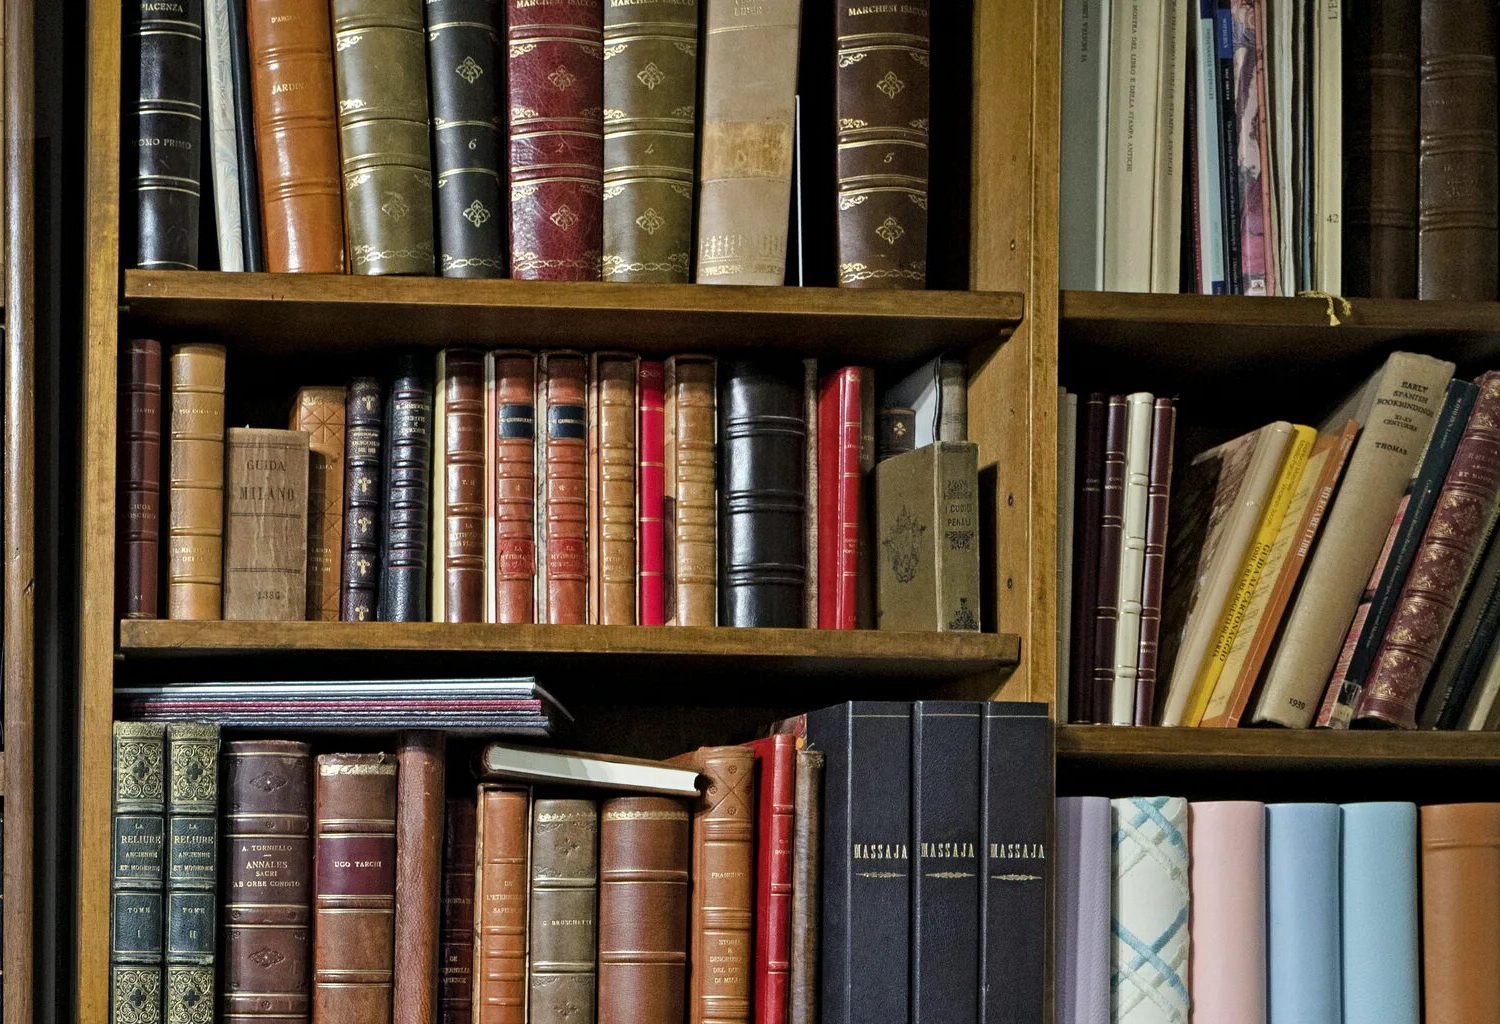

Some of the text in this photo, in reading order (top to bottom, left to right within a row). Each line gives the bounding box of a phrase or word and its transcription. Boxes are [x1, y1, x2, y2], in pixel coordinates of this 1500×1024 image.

[848, 5, 898, 17] MARCHESI
[468, 138, 478, 150] 6
[555, 142, 565, 154] 2
[884, 152, 894, 164] 5
[1326, 213, 1340, 224] 42
[1374, 442, 1408, 456] THOMAS
[246, 459, 286, 472] GUIDA
[239, 486, 295, 501] MILANO
[121, 835, 162, 845] RELIURE
[174, 835, 214, 845] RELIURE
[854, 843, 908, 860] MASSAJA
[920, 843, 975, 860] MASSAJA
[990, 843, 1044, 860] MASSAJA
[246, 860, 288, 870] ANNALES
[334, 860, 382, 868] UGO TARCHI
[246, 880, 267, 888] ORBE
[270, 880, 300, 888] CONDITO
